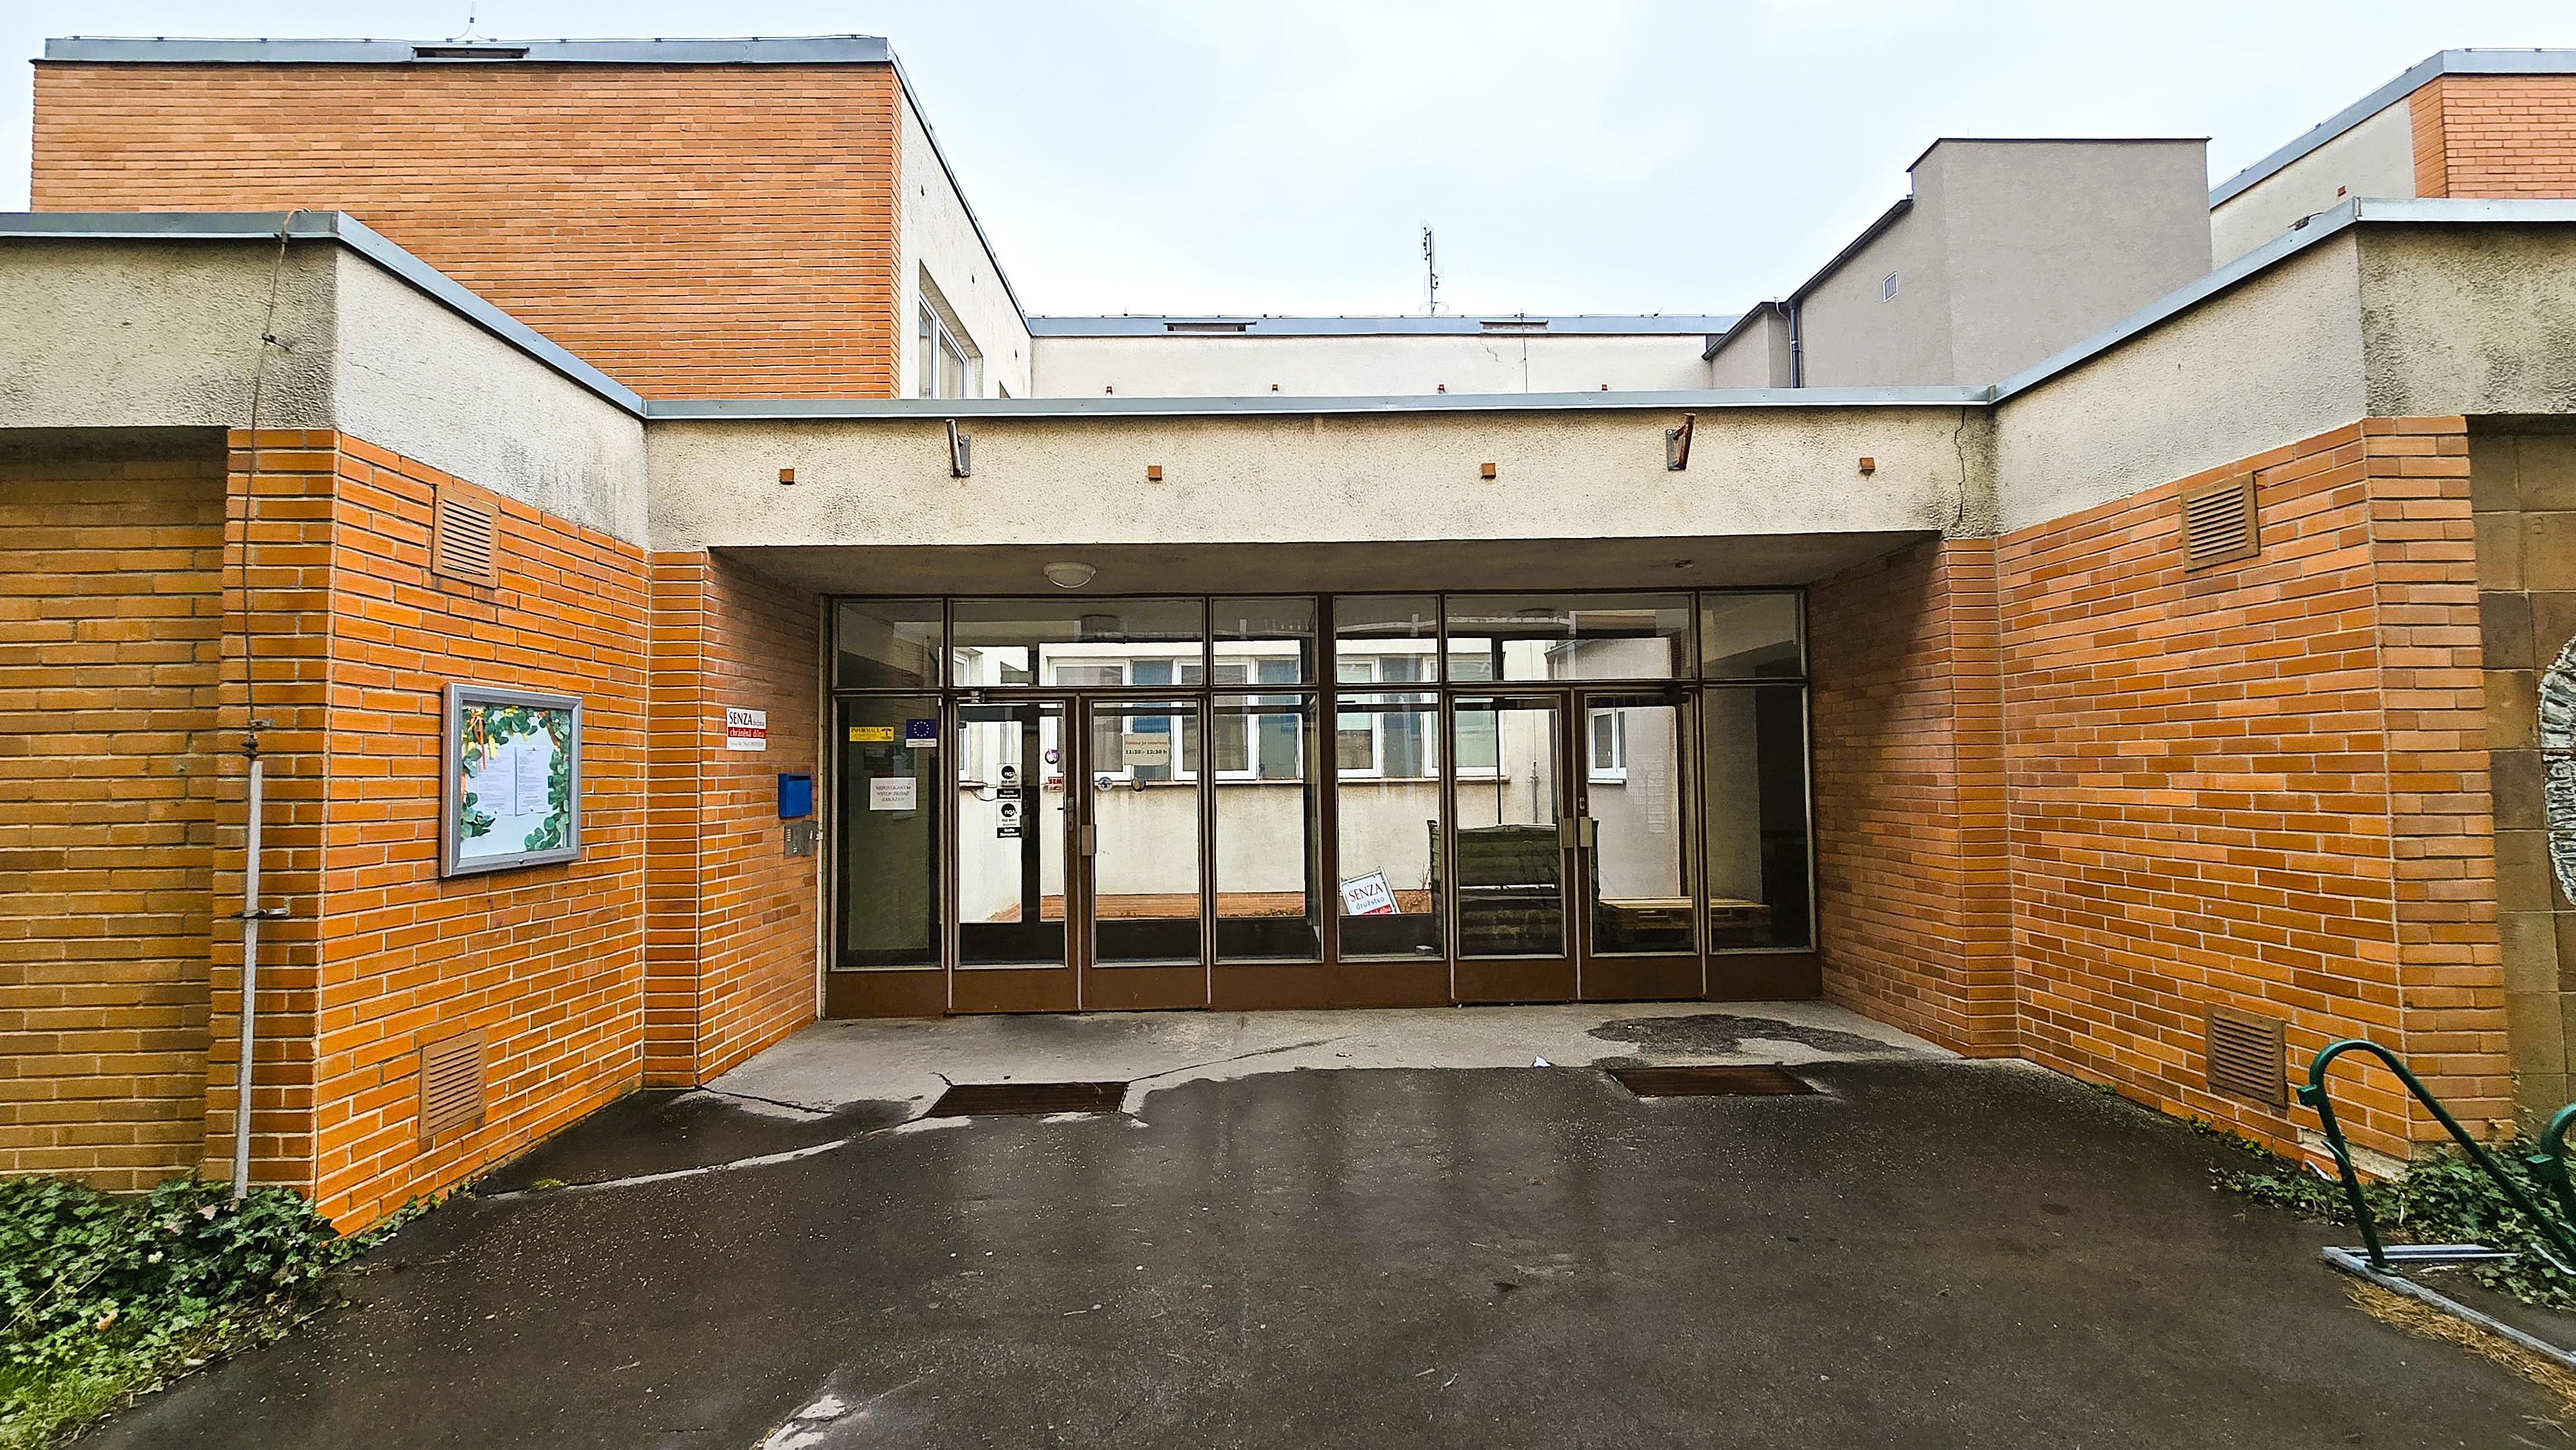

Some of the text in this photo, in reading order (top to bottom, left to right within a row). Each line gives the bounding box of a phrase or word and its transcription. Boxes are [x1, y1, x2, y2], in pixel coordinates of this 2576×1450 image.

[729, 711, 753, 725] SENZA
[1348, 883, 1383, 902] SENZA
[1355, 896, 1385, 910] družstvo
